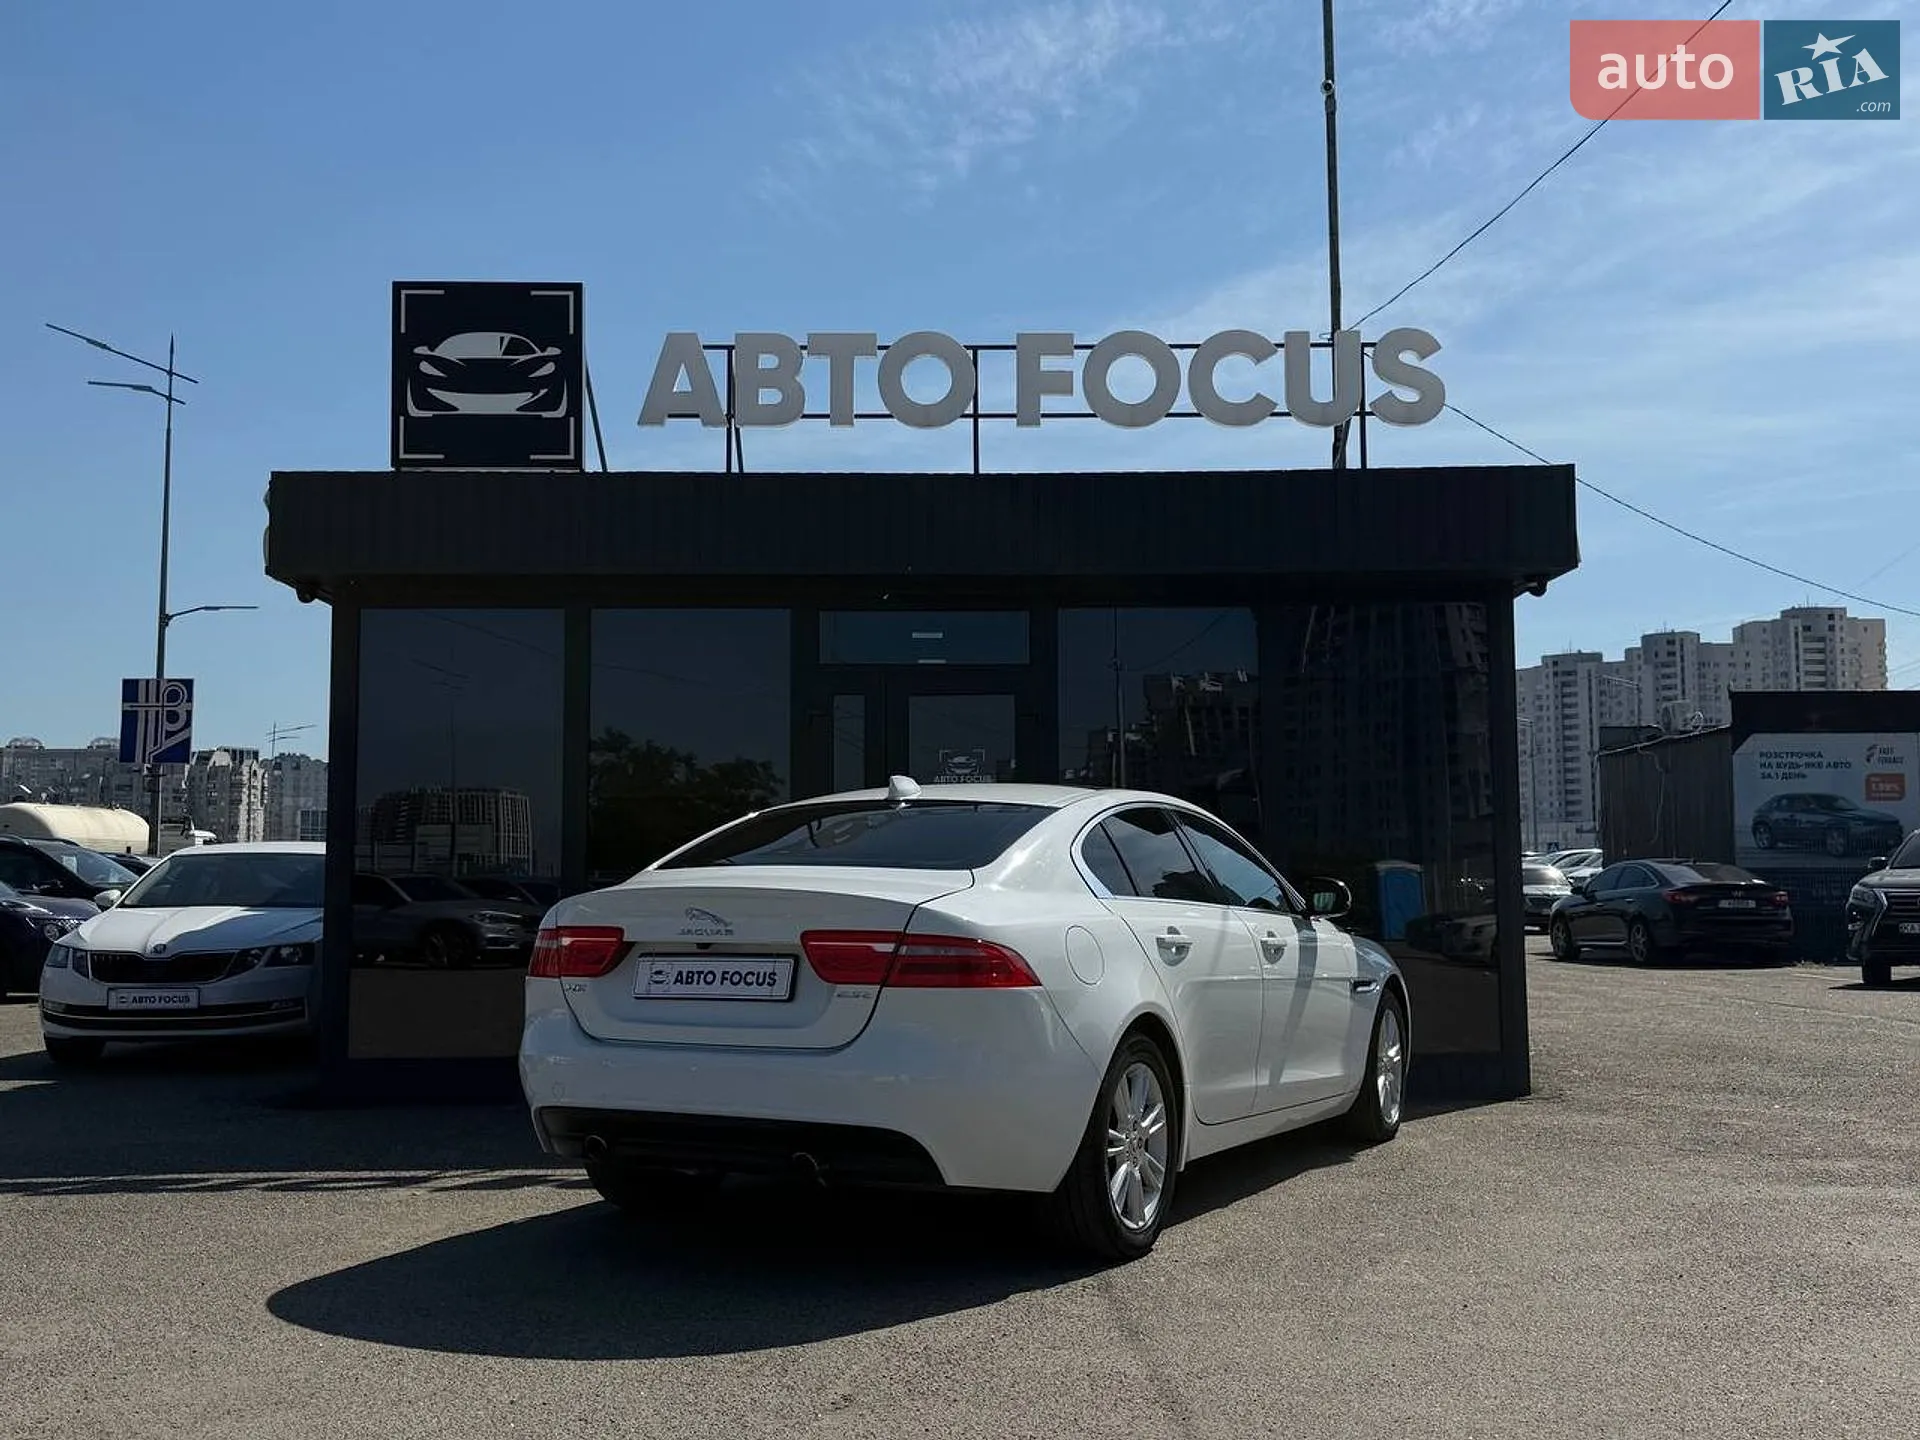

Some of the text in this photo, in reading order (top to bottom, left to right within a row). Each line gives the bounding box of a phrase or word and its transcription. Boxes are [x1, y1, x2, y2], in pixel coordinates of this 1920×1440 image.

[637, 327, 1447, 430] АВТО FOCUS
[1758, 750, 1824, 760] РОЗСТРОЧКА
[678, 928, 734, 936] JAGUAR
[673, 969, 777, 988] АВТО FOCUS
